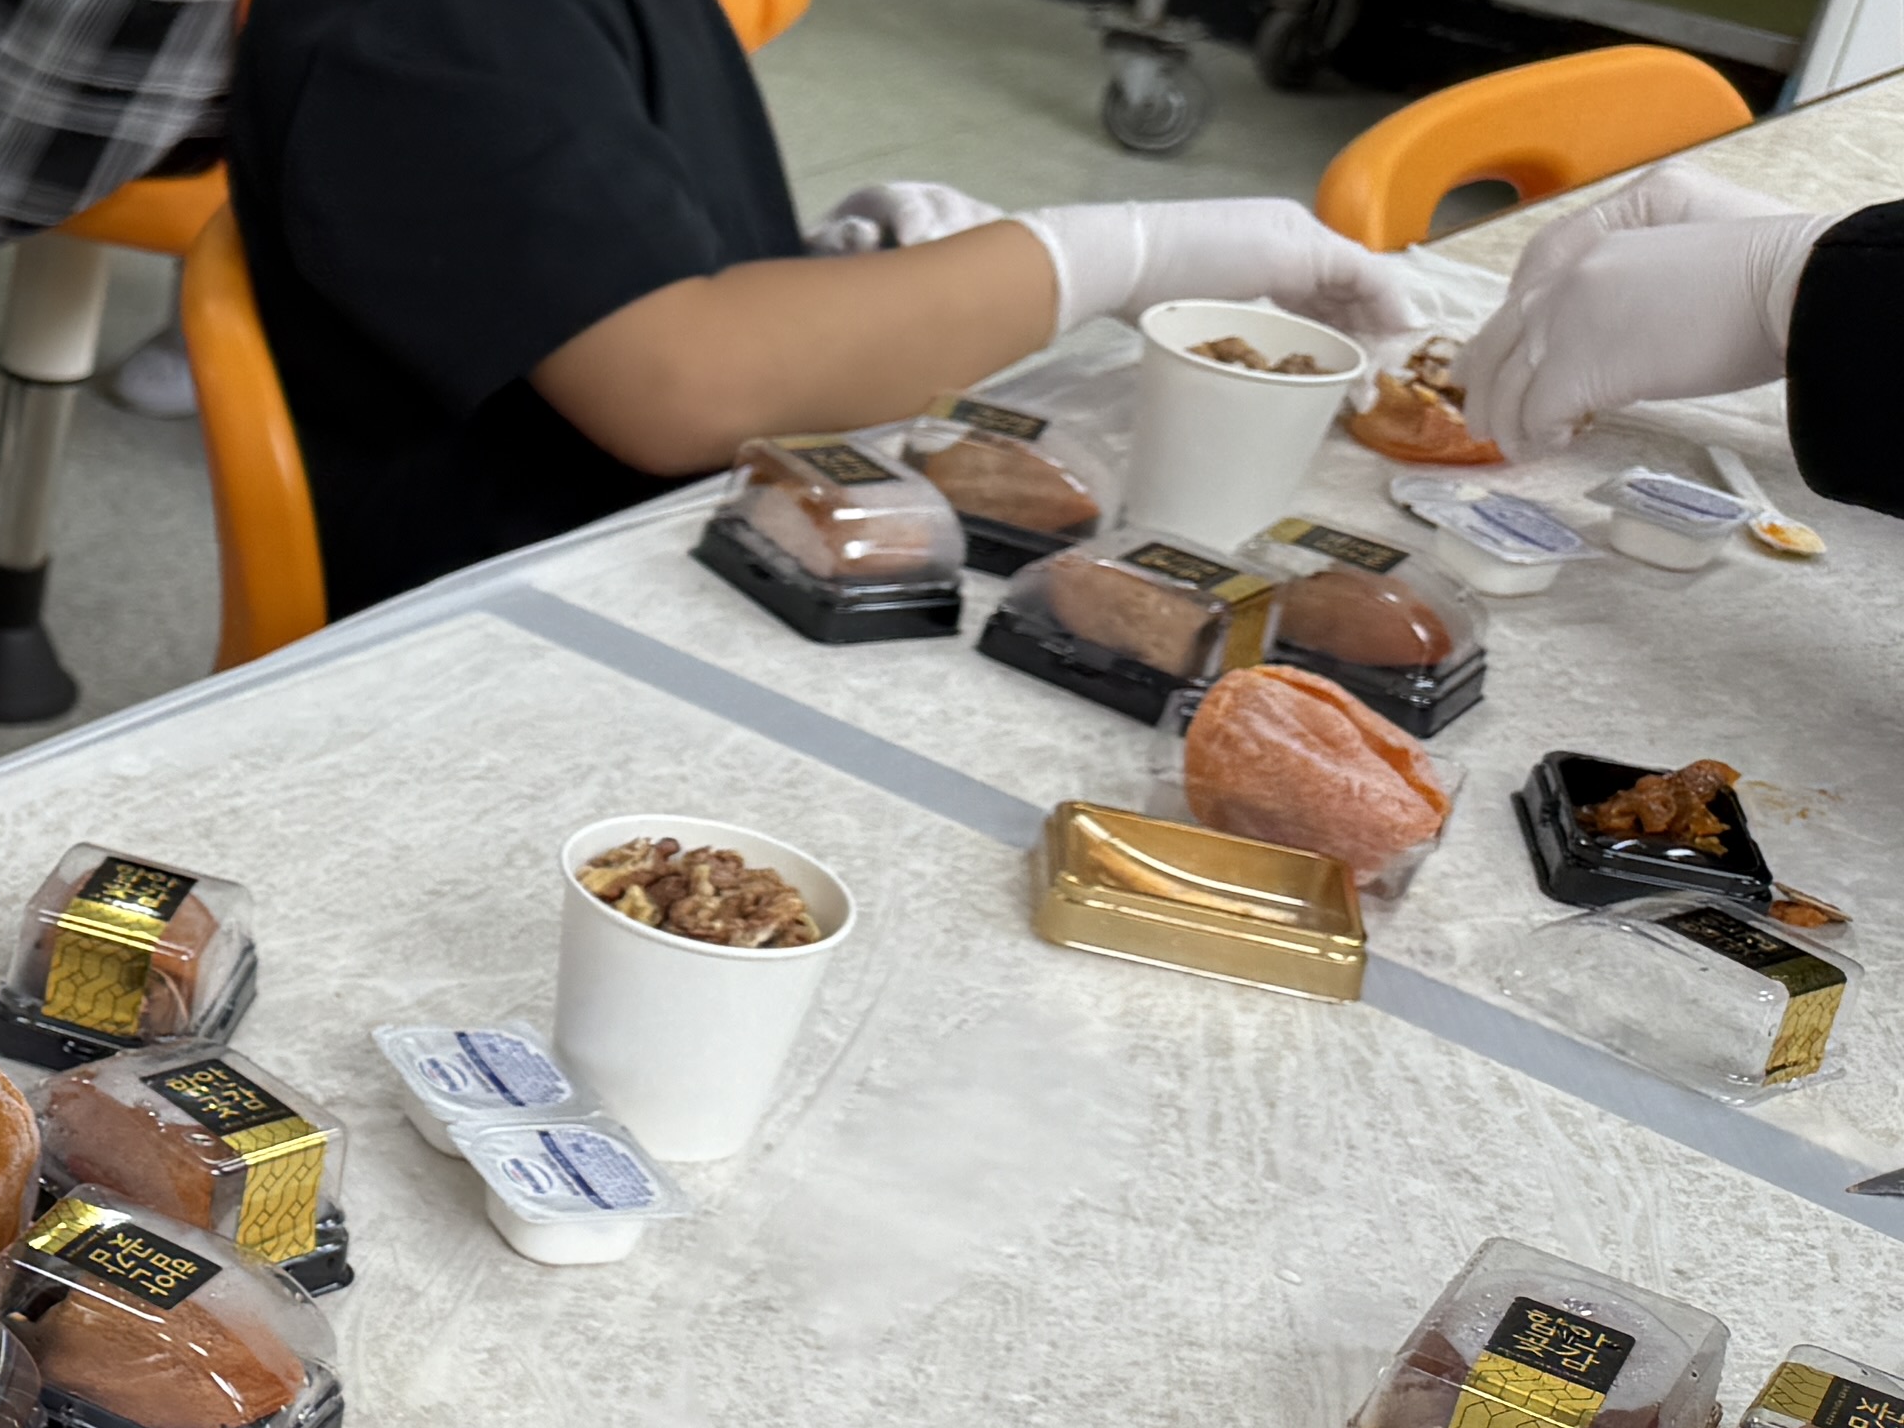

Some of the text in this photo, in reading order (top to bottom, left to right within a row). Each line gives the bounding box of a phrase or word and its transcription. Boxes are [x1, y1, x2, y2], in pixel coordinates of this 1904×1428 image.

[88, 1232, 156, 1275] 곶감
[128, 1253, 199, 1297] 함안
[1512, 1330, 1600, 1372] 곶감
